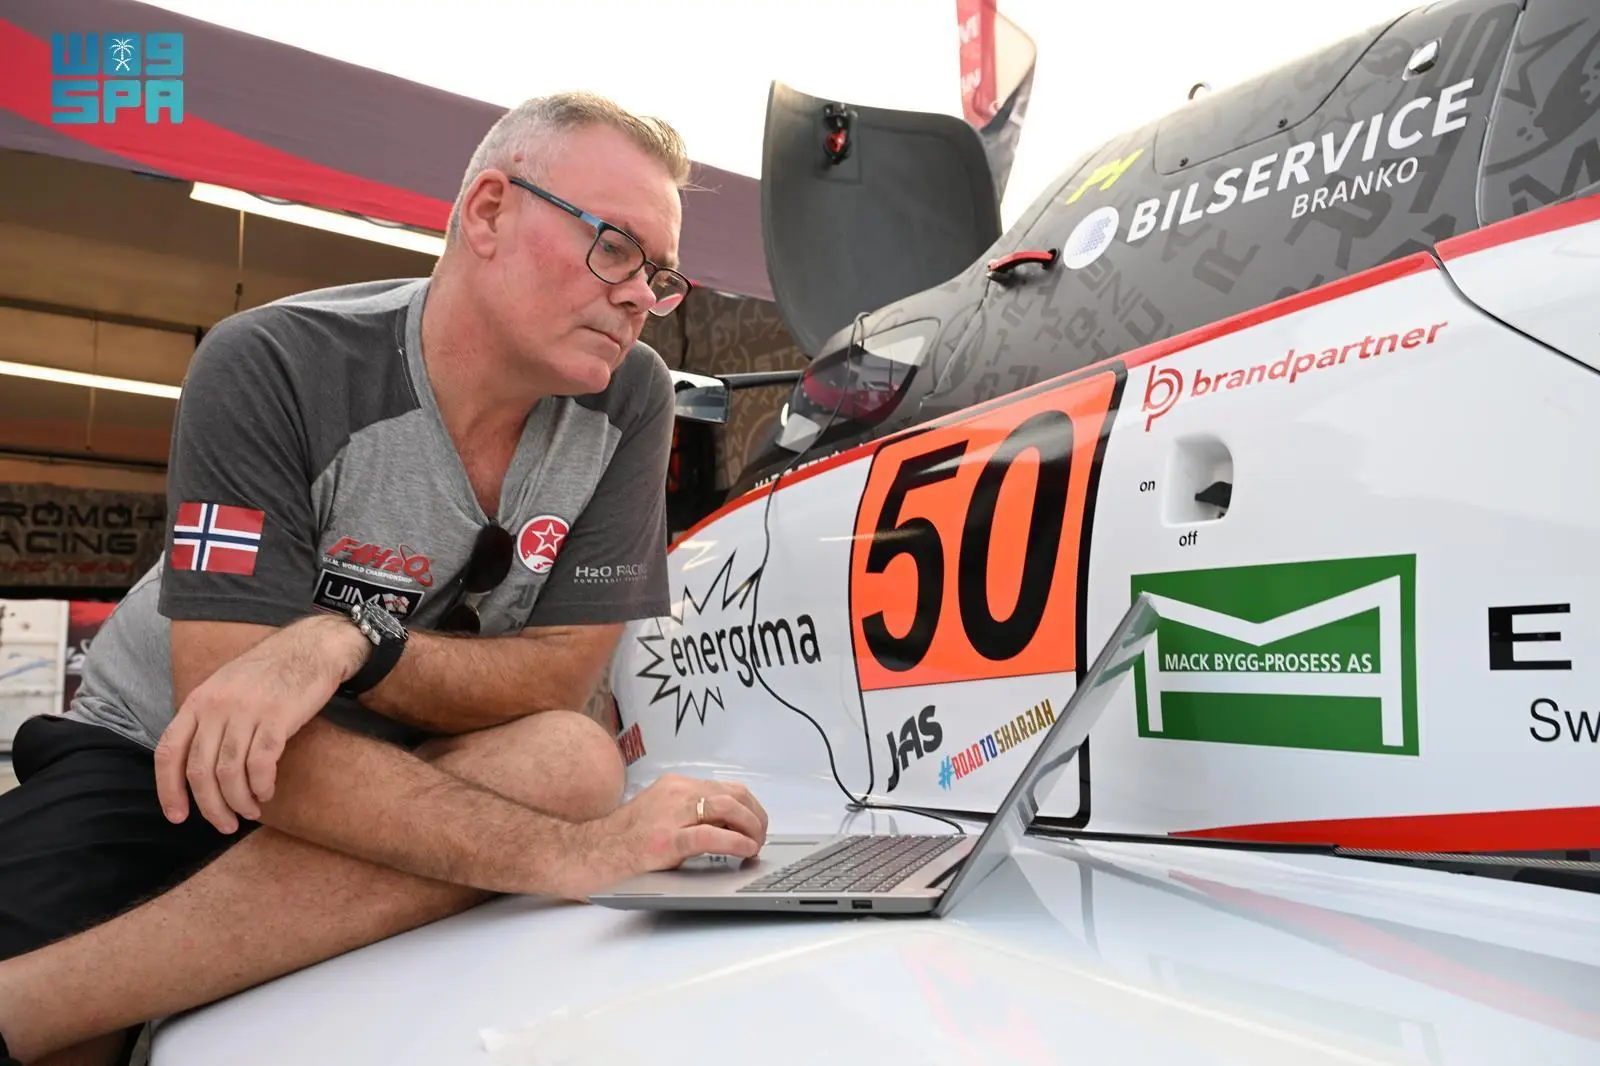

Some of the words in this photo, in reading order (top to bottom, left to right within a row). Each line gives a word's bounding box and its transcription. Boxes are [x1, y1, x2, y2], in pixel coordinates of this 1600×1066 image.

[1126, 78, 1475, 244] BILSERVICE
[1291, 156, 1419, 220] BRANKO
[1190, 321, 1448, 397] brandpartner
[1139, 478, 1156, 493] on
[342, 562, 364, 573] WORLD
[575, 565, 612, 577] H2O
[862, 410, 1074, 672] 50
[1178, 531, 1198, 548] off
[670, 613, 822, 688] energima
[1165, 653, 1210, 672] MACK
[1214, 653, 1341, 672] BYGG-PROSESS
[1347, 653, 1373, 673] AS
[886, 704, 943, 793] JAS
[937, 698, 1057, 791] #ROADTOSHARJAH
[1529, 697, 1600, 743] Sw
